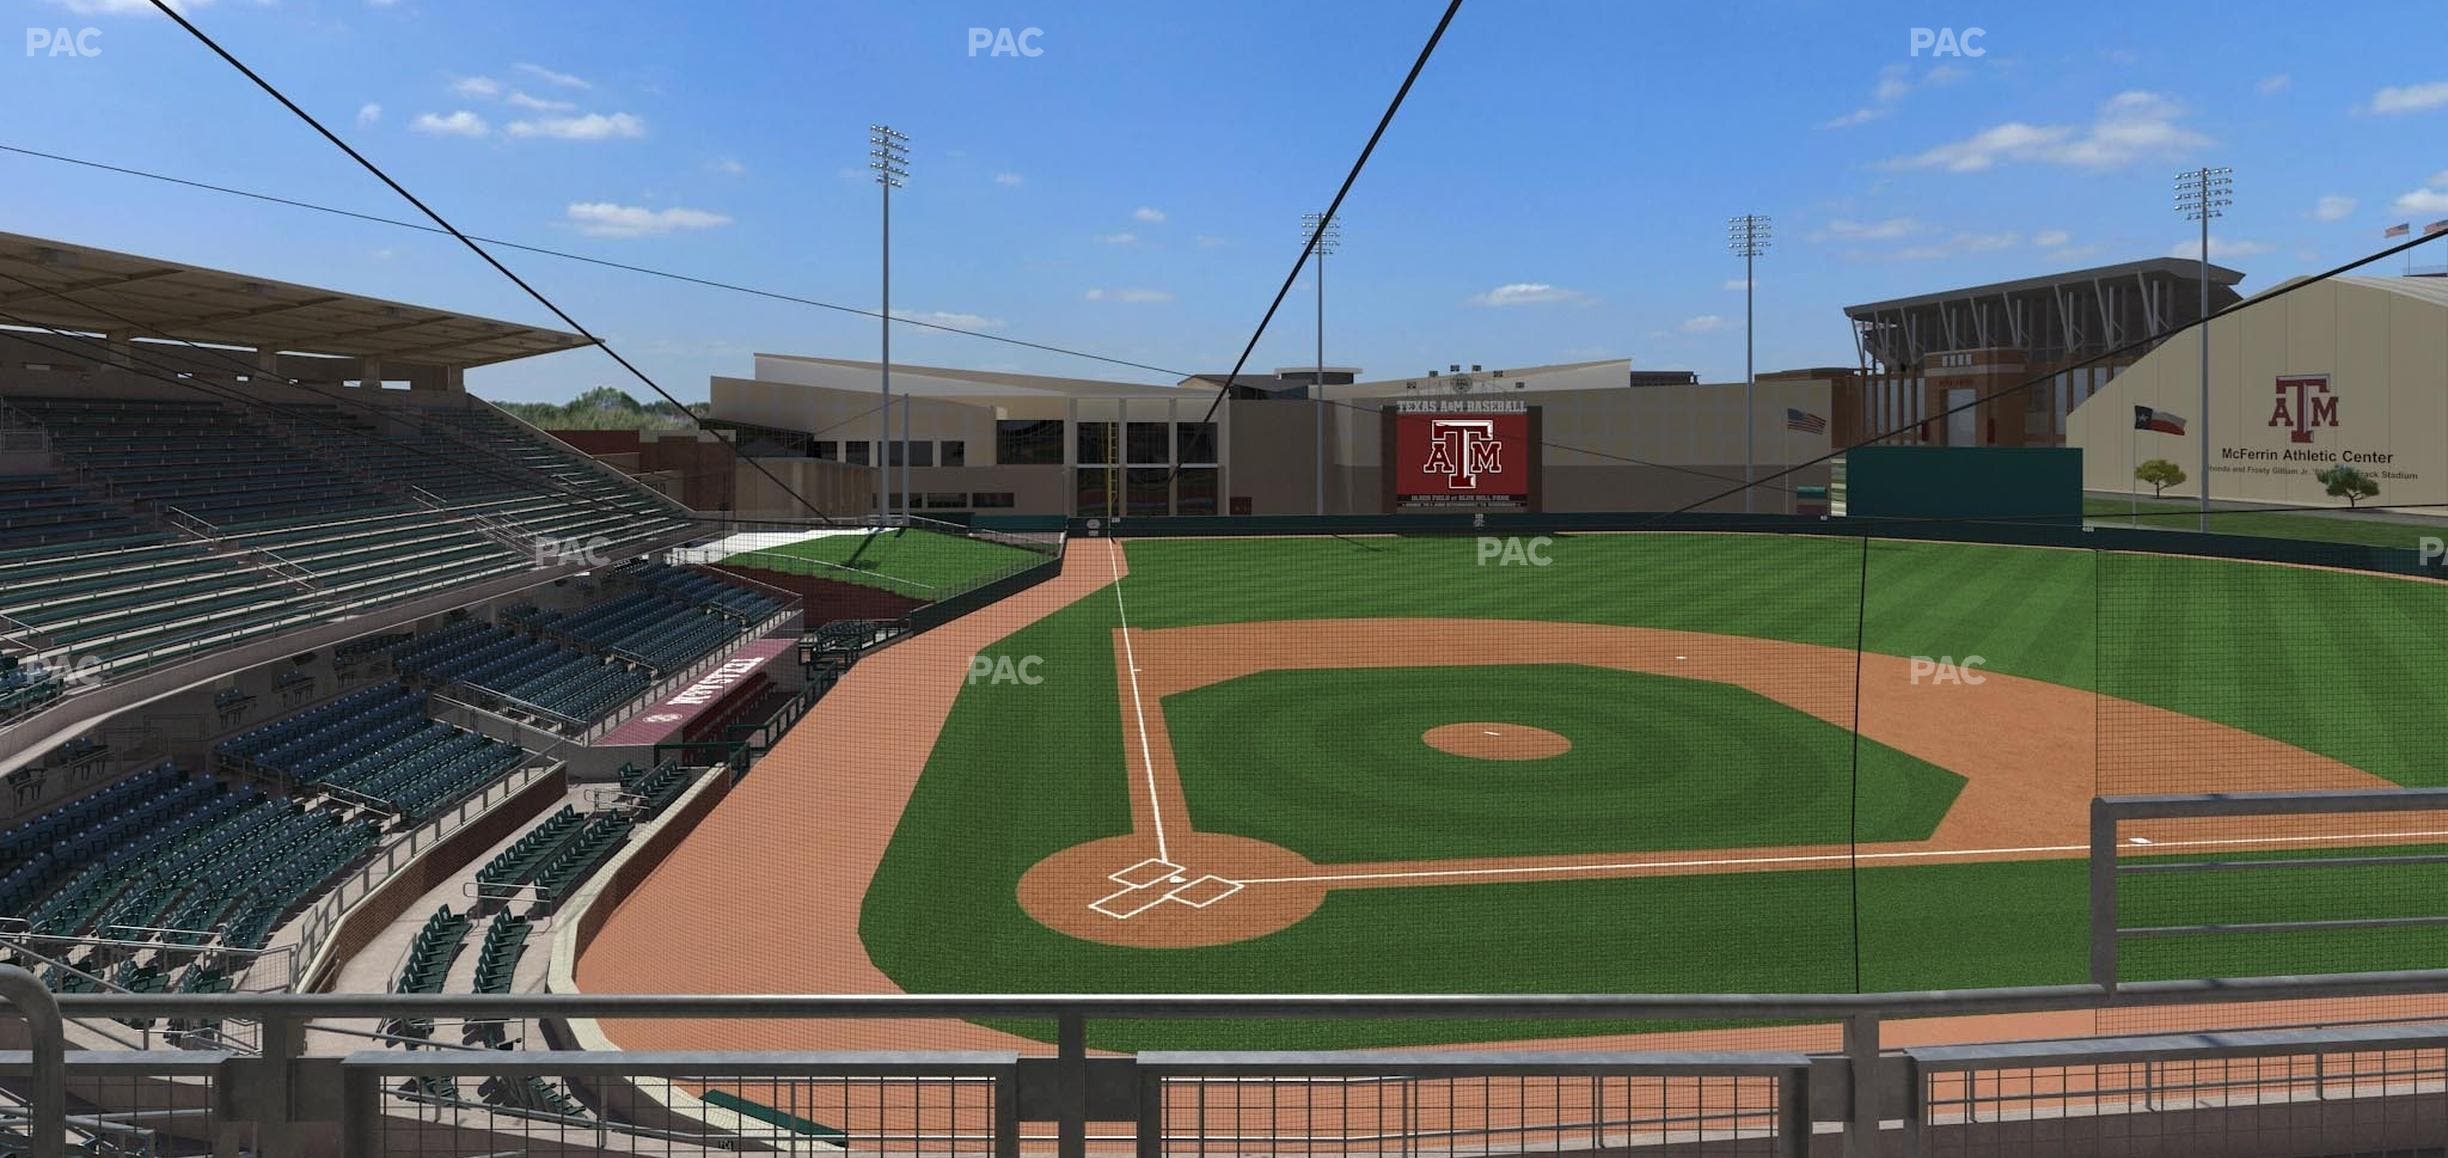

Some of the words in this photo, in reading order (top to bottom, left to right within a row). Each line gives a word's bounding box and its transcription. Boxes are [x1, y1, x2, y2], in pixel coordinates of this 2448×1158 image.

[1397, 400, 1437, 413] TEXAS
[1440, 400, 1464, 413] A&M
[1466, 400, 1528, 413] BASEBALL
[2222, 447, 2278, 461] McFerrin
[2283, 449, 2337, 462] Athletic
[2343, 450, 2394, 464] Center
[2381, 471, 2418, 480] Stadium
